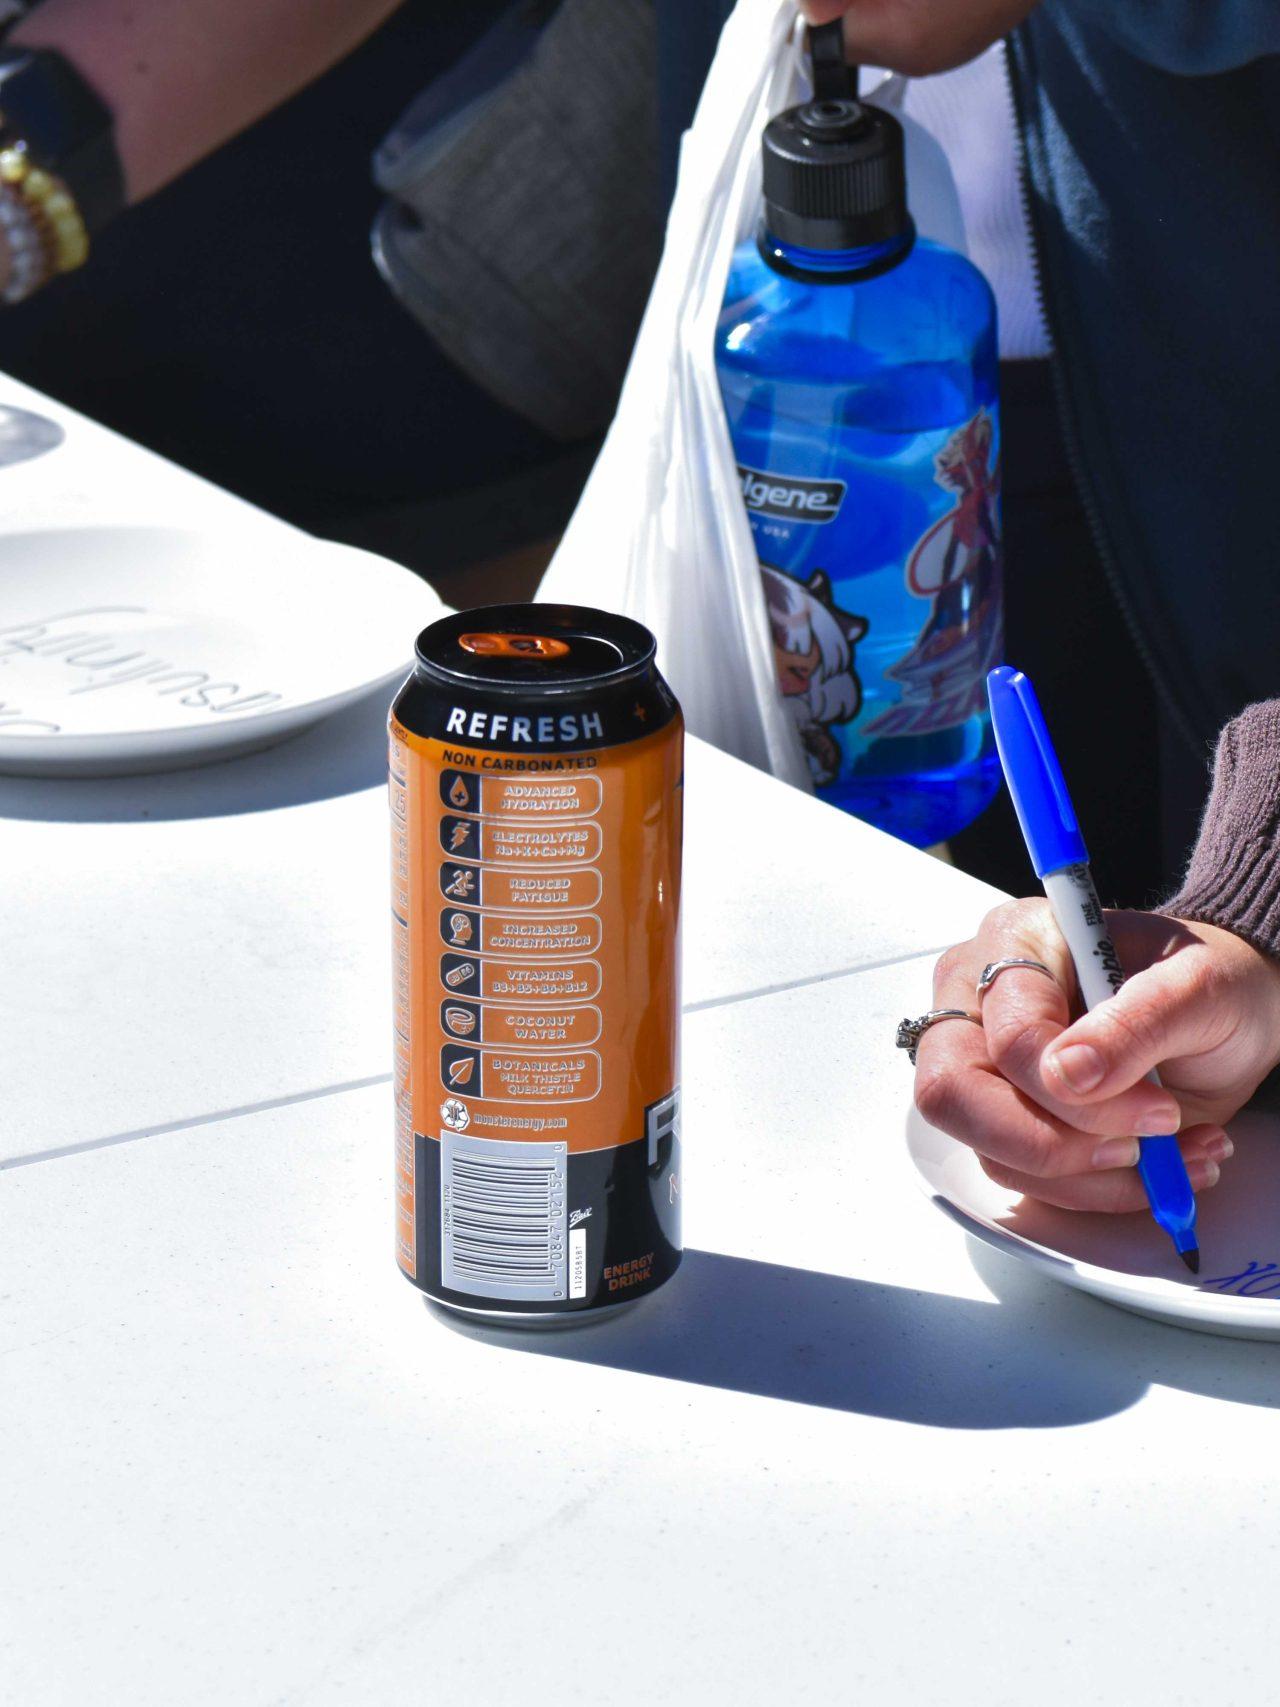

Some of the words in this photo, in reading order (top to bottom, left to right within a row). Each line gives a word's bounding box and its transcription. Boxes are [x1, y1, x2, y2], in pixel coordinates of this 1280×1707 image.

[743, 472, 840, 511] lgene
[446, 707, 604, 743] REFRESH
[442, 750, 476, 768] NON
[482, 756, 597, 772] CARBONATED
[504, 785, 577, 797] ADVANCED
[501, 797, 580, 811] HYDRATION
[492, 831, 589, 844] ELECTROLYTES
[509, 878, 571, 890] REDUCED
[511, 891, 569, 903] FATIGUE
[1081, 902, 1098, 927] FINE
[502, 923, 578, 936] INCREASED
[489, 935, 591, 949] CONCENTRATION
[507, 969, 574, 982] VITAMINS
[505, 1015, 576, 1027] COCONUT
[514, 1028, 567, 1040] WATER
[492, 1059, 586, 1073] BOTANICALS
[500, 1073, 529, 1083] MILK
[532, 1073, 582, 1084] THISTLE
[507, 1084, 574, 1096] QUERCETIN
[474, 1113, 568, 1130] monsterenergy.com
[549, 1171, 564, 1219] 02152
[549, 1225, 564, 1270] 70847
[603, 1252, 655, 1279] ENERGY
[609, 1267, 652, 1291] DRINK
